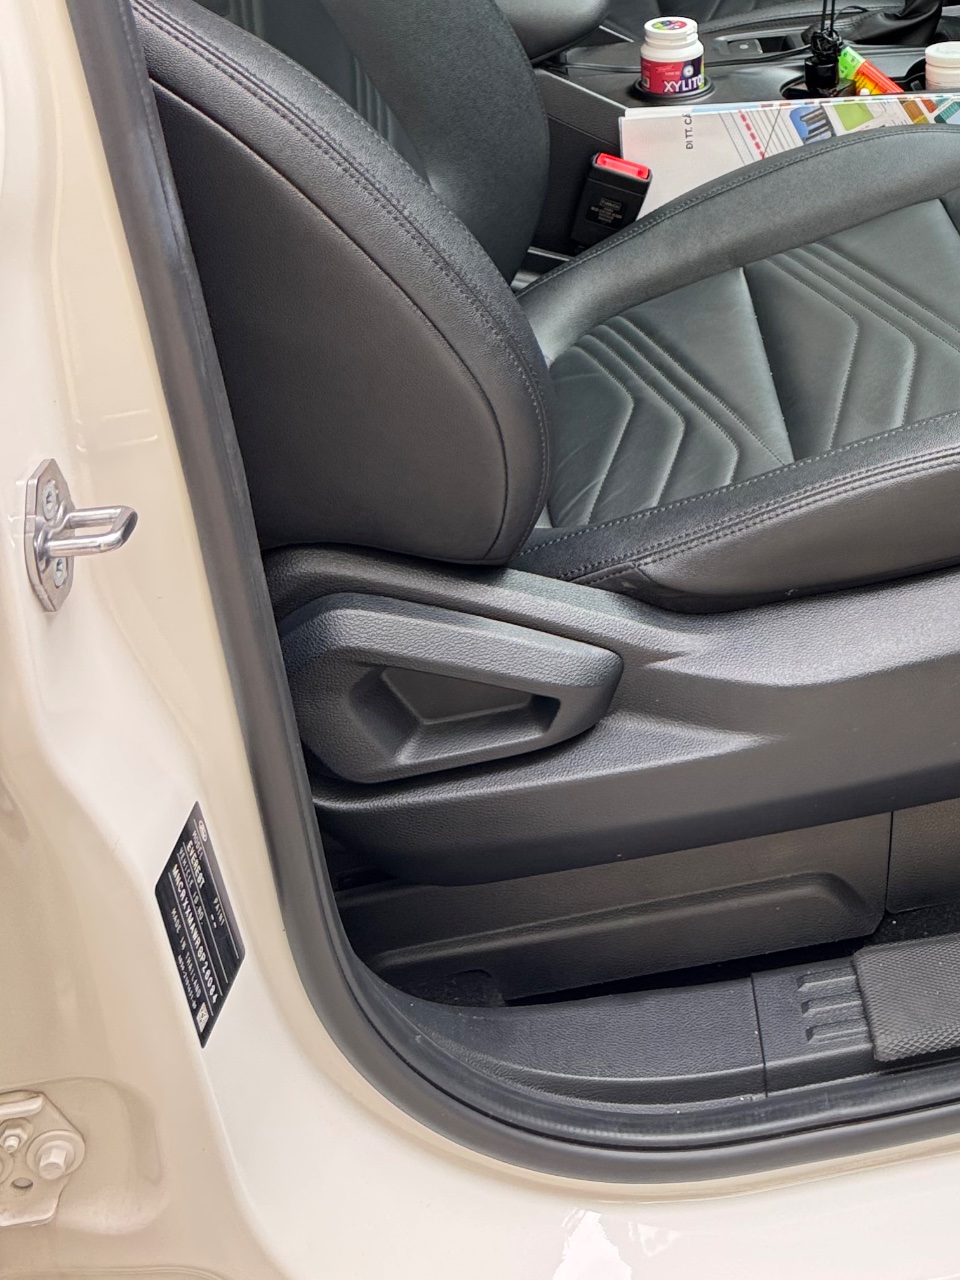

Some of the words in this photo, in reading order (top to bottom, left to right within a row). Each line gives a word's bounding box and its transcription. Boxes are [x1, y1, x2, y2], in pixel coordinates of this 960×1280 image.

[179, 846, 194, 888] VEHICLE
[187, 839, 205, 889] EVEREST
[192, 830, 204, 861] MODEL
[171, 906, 182, 934] MADE
[179, 935, 187, 951] IN
[185, 951, 202, 999] THAILAND
